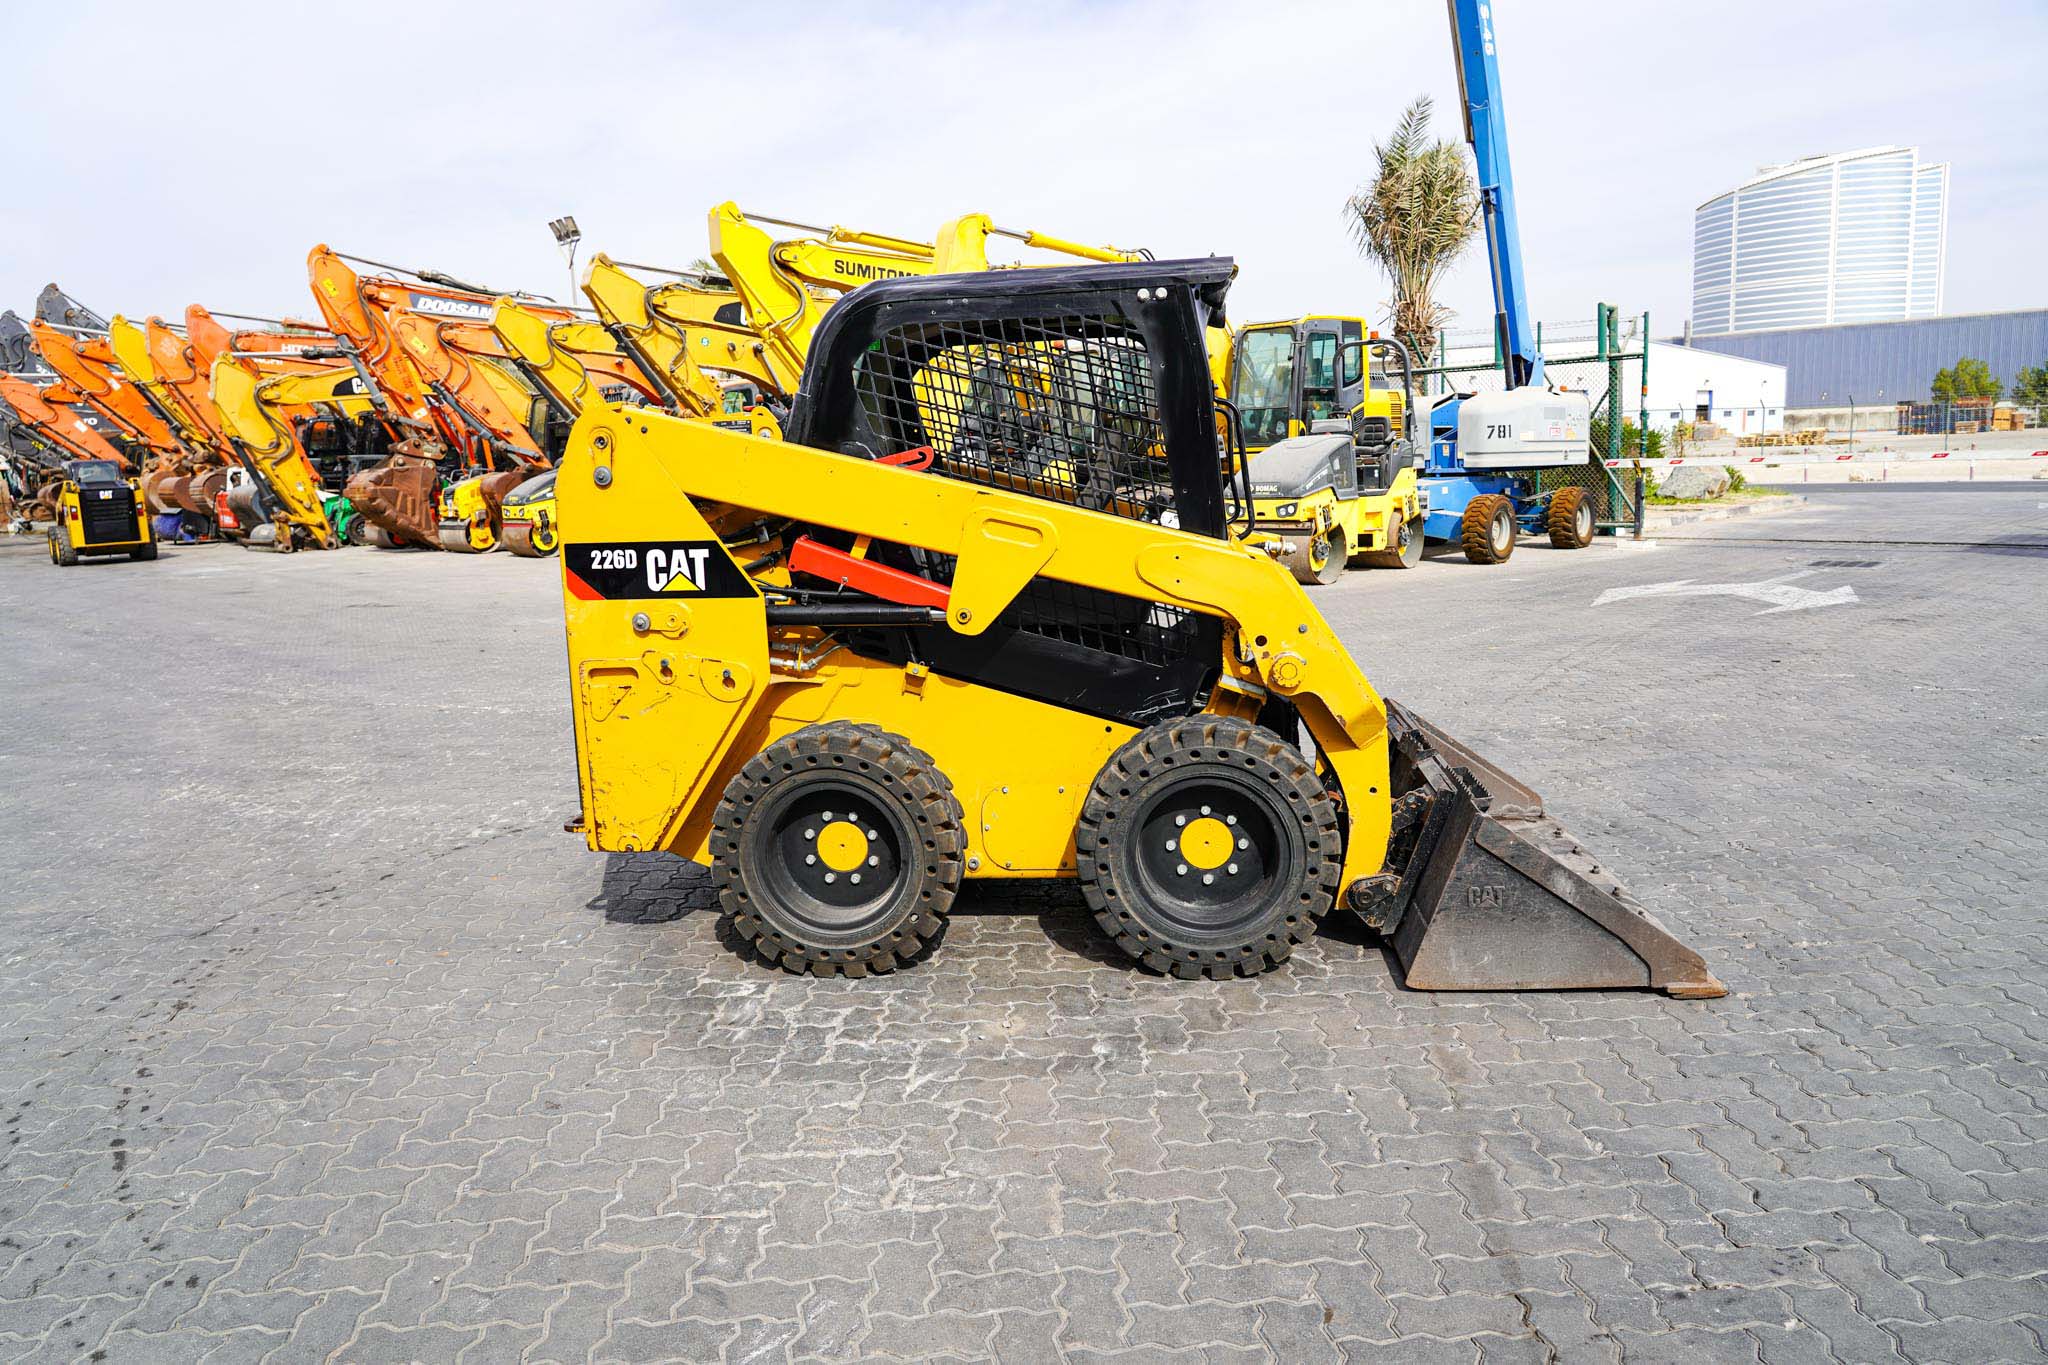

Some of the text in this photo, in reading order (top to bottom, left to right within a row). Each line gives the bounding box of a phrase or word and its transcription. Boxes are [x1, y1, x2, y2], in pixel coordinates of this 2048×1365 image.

[834, 259, 920, 280] SUMITO
[416, 297, 492, 318] DOOSAN
[1487, 424, 1512, 439] 781
[99, 490, 113, 500] CAT
[590, 548, 710, 592] 226D CAT
[1467, 886, 1505, 911] CAT
